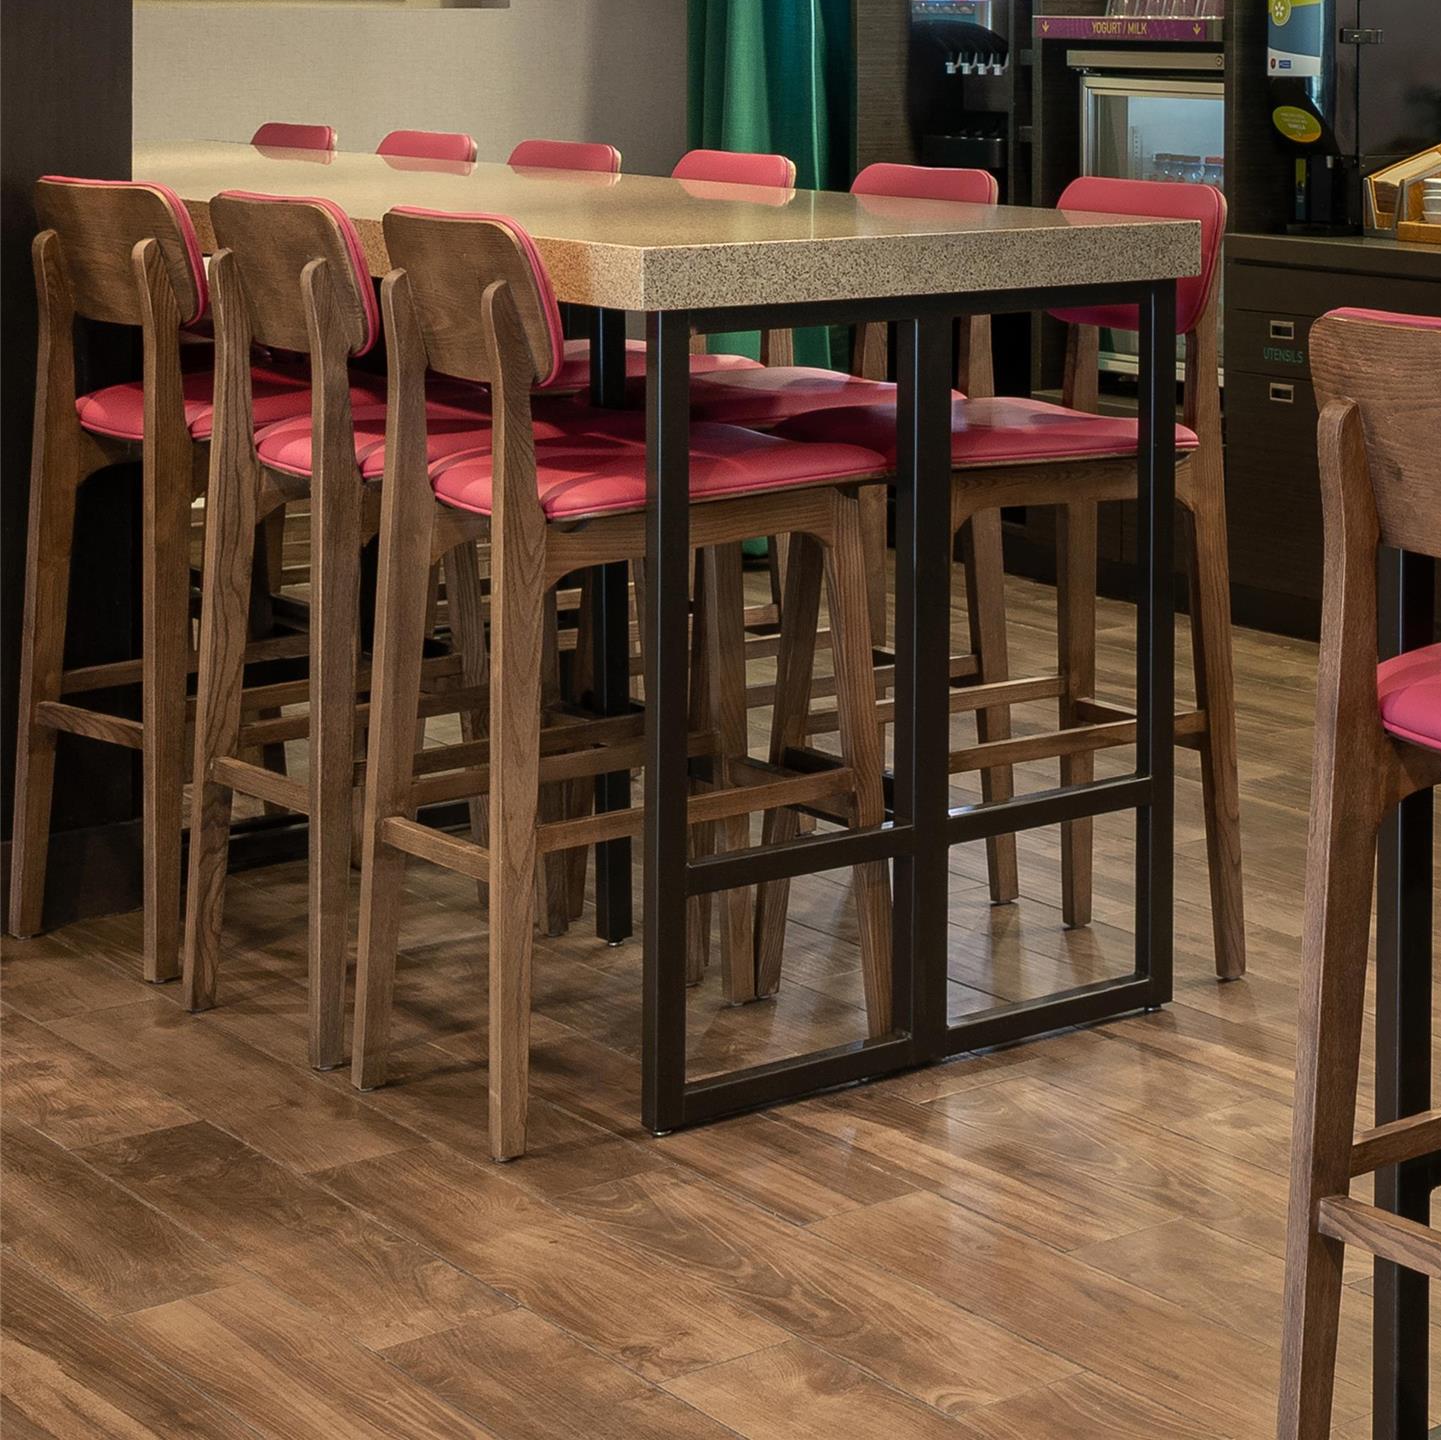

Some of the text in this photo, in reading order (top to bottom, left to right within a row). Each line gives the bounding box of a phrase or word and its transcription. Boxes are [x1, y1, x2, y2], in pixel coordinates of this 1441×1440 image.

[1091, 22, 1121, 35] YOGURT
[1127, 22, 1148, 35] MILK
[1263, 346, 1304, 363] UTENSILS
